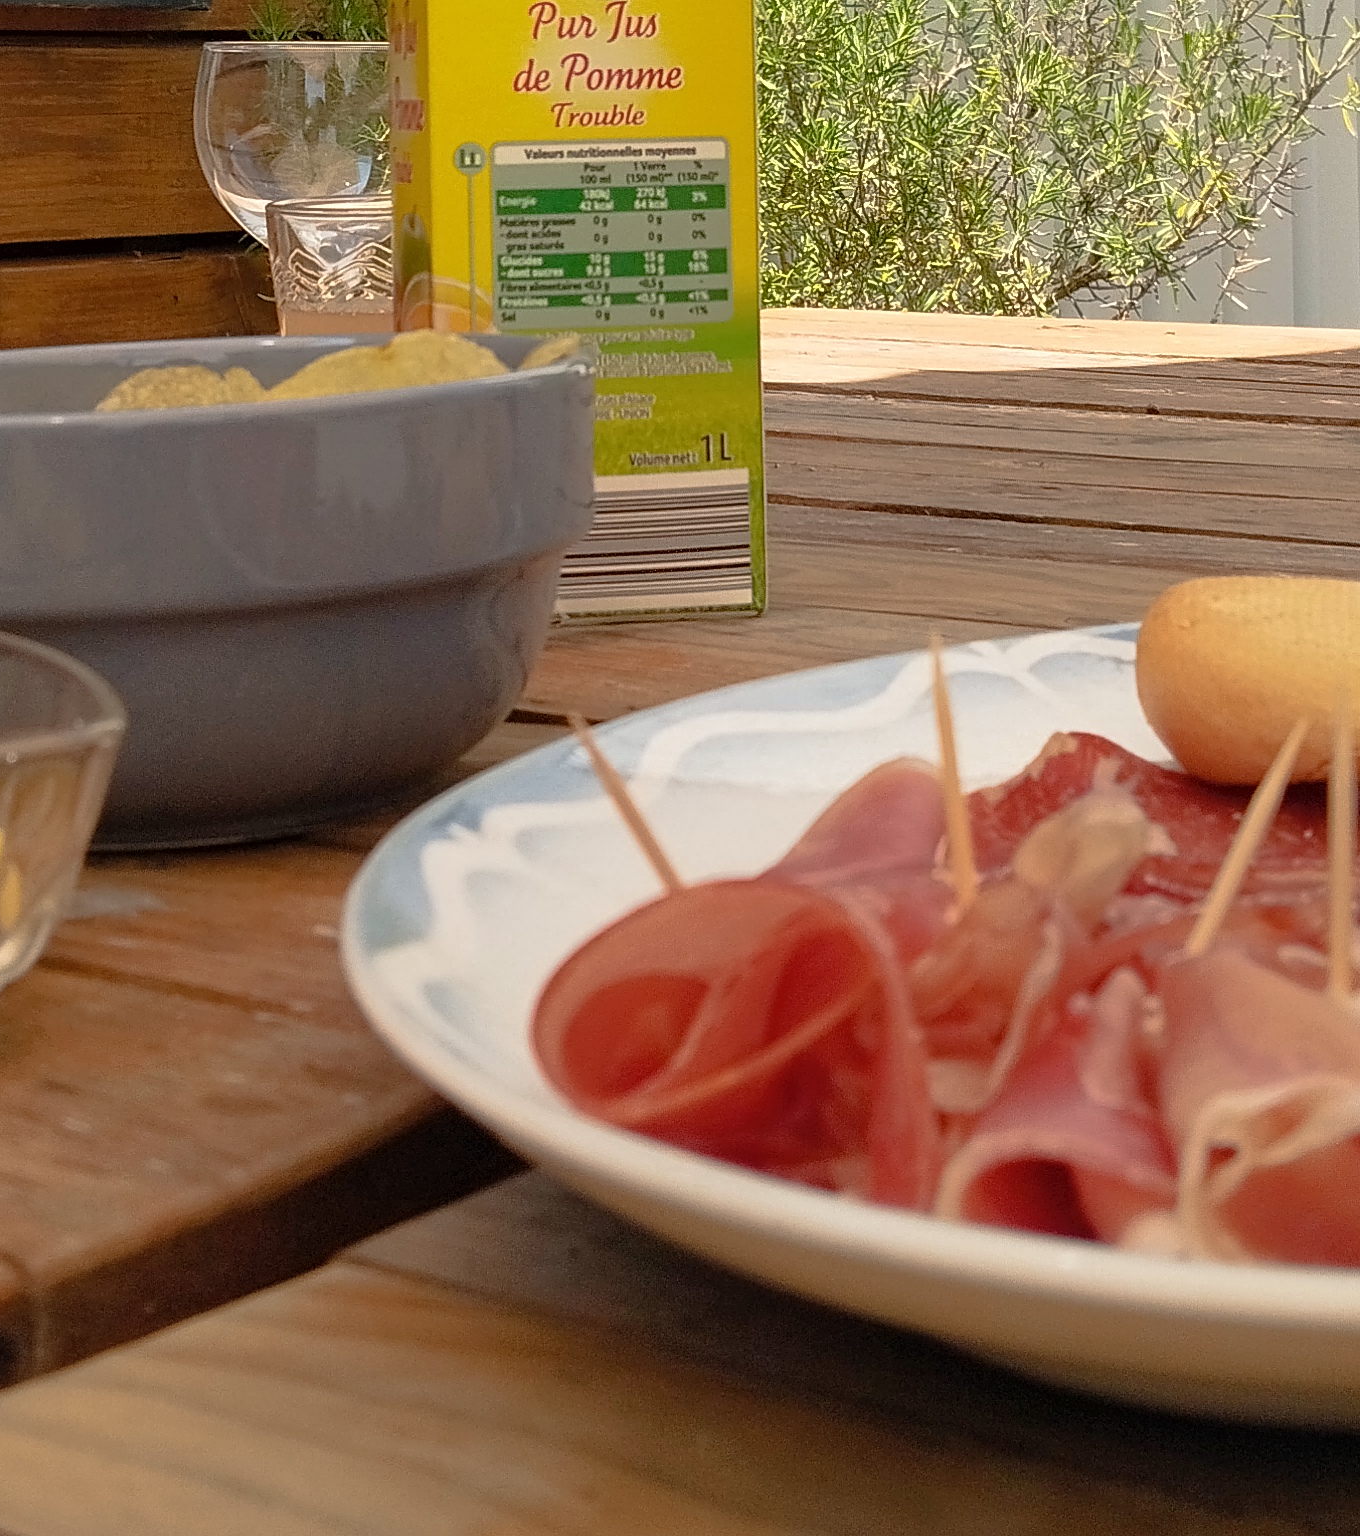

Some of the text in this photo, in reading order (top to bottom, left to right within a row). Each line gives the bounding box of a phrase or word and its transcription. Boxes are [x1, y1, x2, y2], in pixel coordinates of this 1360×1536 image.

[528, 0, 658, 43] Pur Jus
[513, 53, 683, 92] de Pomme
[551, 102, 645, 128] Trouble
[524, 146, 697, 160] Valeurs nutritionnelles moyennes
[580, 174, 597, 184] 100
[629, 453, 671, 466] Volume
[700, 432, 732, 462] 1 L
